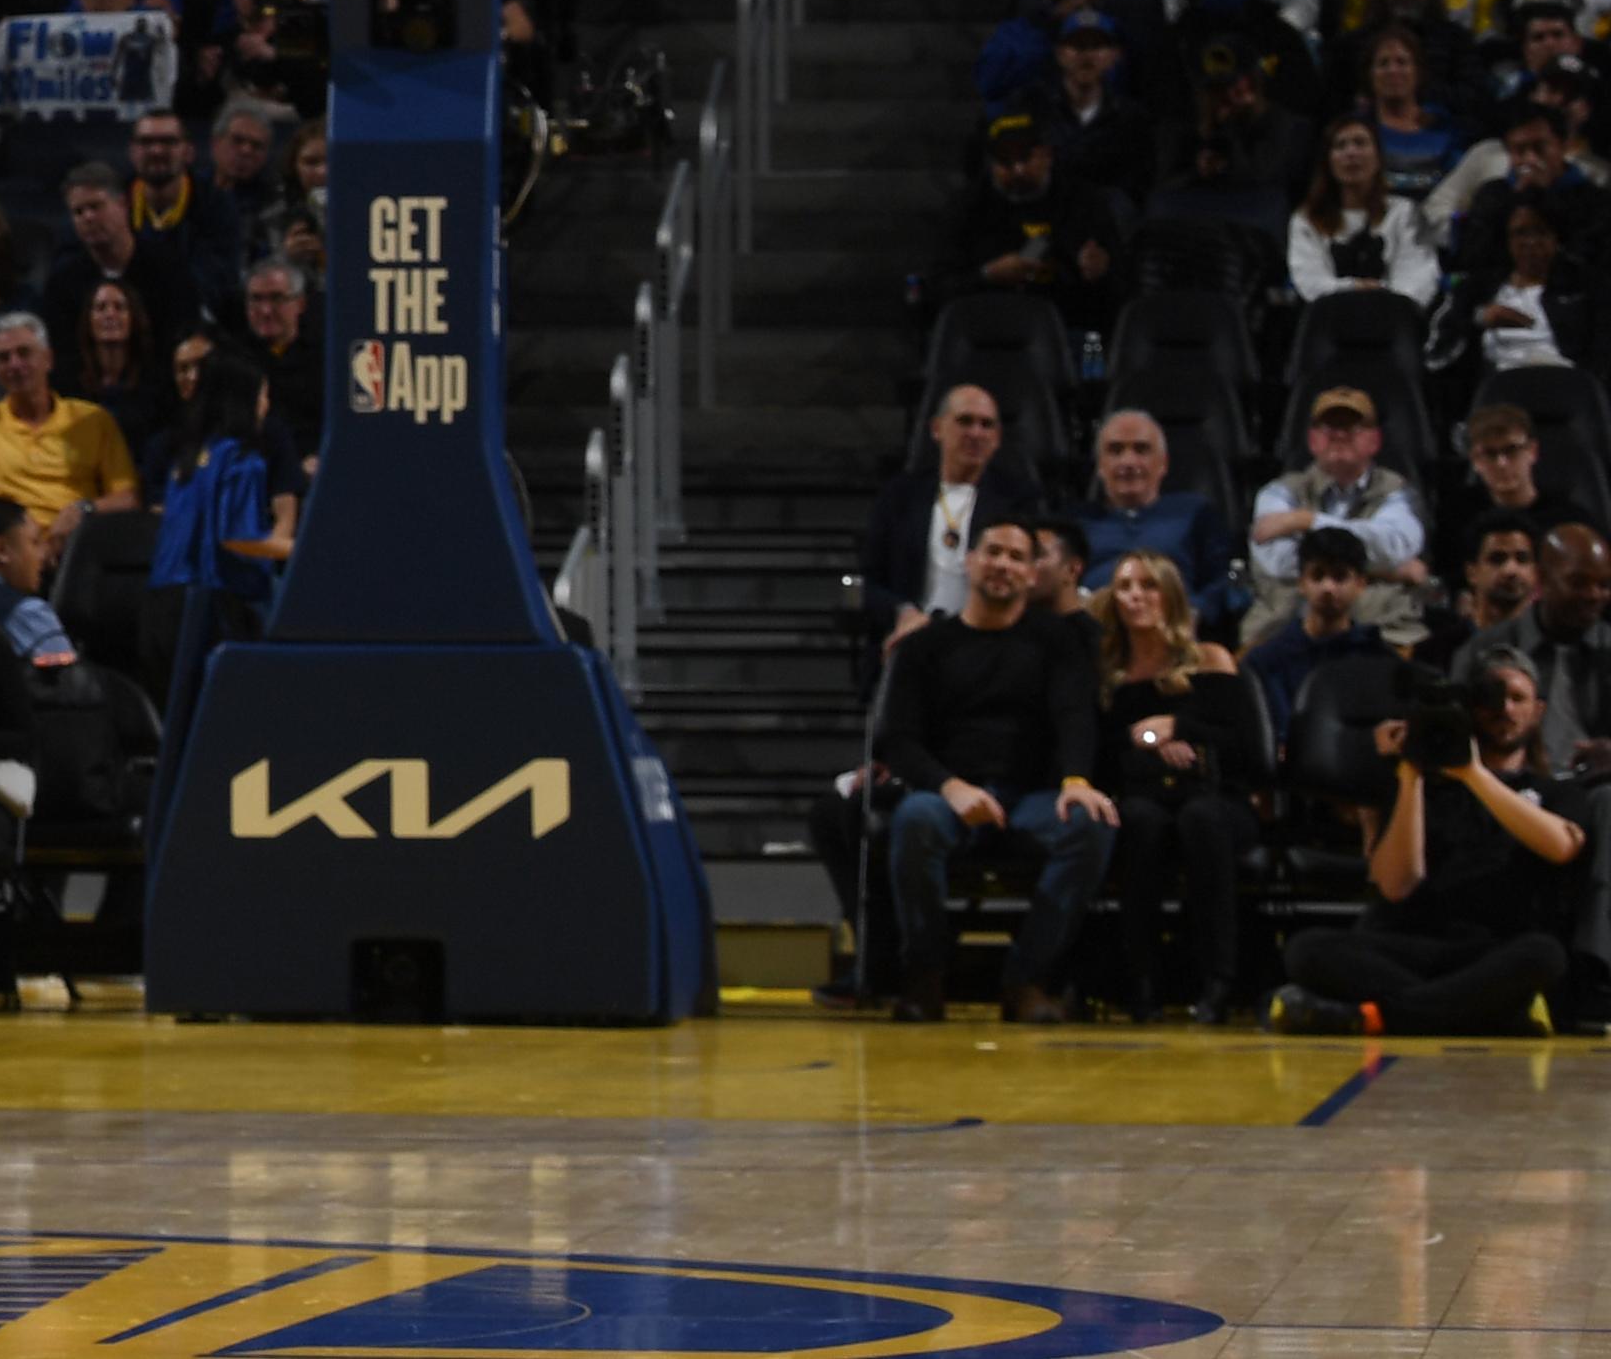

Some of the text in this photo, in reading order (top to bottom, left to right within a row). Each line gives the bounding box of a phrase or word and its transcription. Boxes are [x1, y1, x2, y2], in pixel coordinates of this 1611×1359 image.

[368, 194, 449, 264] GET
[368, 266, 449, 335] THE
[387, 340, 468, 425] App
[229, 757, 571, 840] KIA
